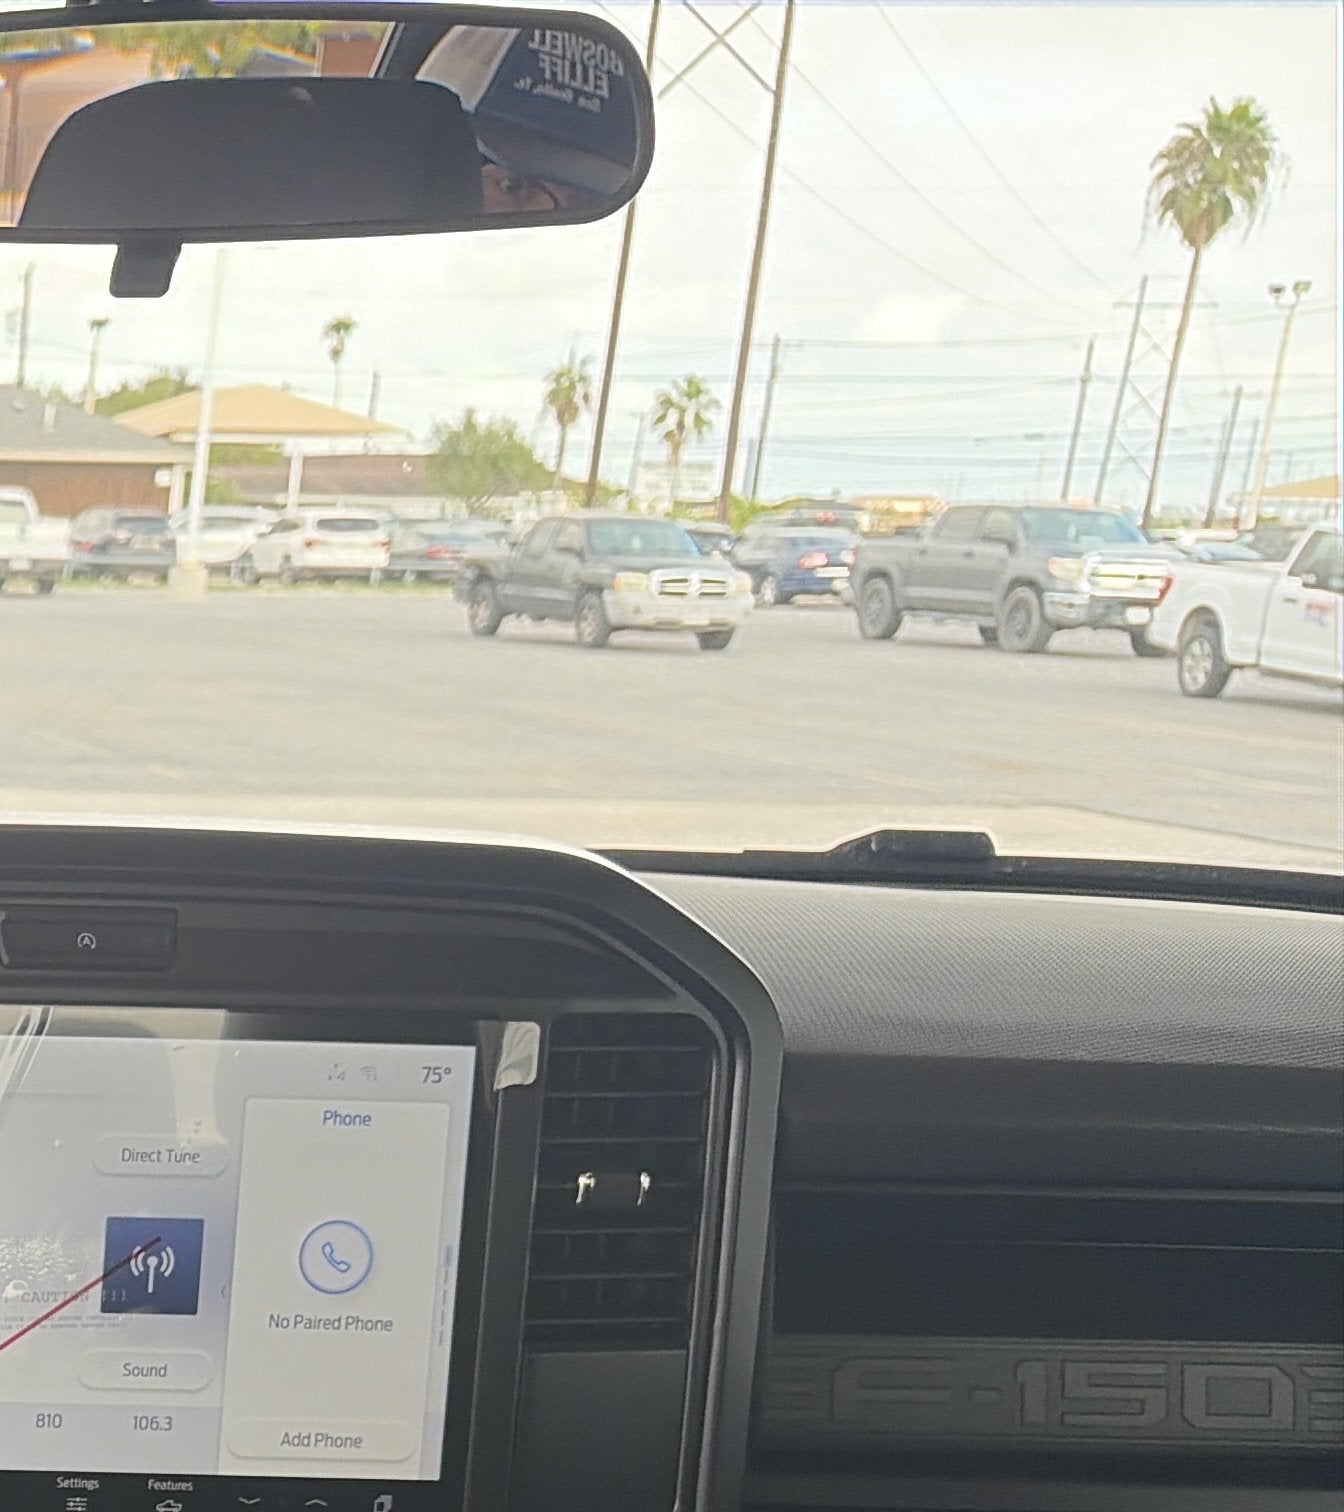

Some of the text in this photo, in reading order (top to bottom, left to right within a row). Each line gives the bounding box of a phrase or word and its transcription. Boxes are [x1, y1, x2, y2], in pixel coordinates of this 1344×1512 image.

[323, 1110, 372, 1128] Phone
[121, 1148, 200, 1164] Direct Tune
[268, 1314, 394, 1332] No Paired Phone
[123, 1363, 168, 1378] Sound
[831, 1356, 1297, 1430] F-150
[35, 1412, 63, 1429] 810
[133, 1415, 173, 1431] 106.3
[280, 1432, 363, 1449] Add Phone
[56, 1476, 100, 1490] Settings
[147, 1479, 193, 1492] Features
